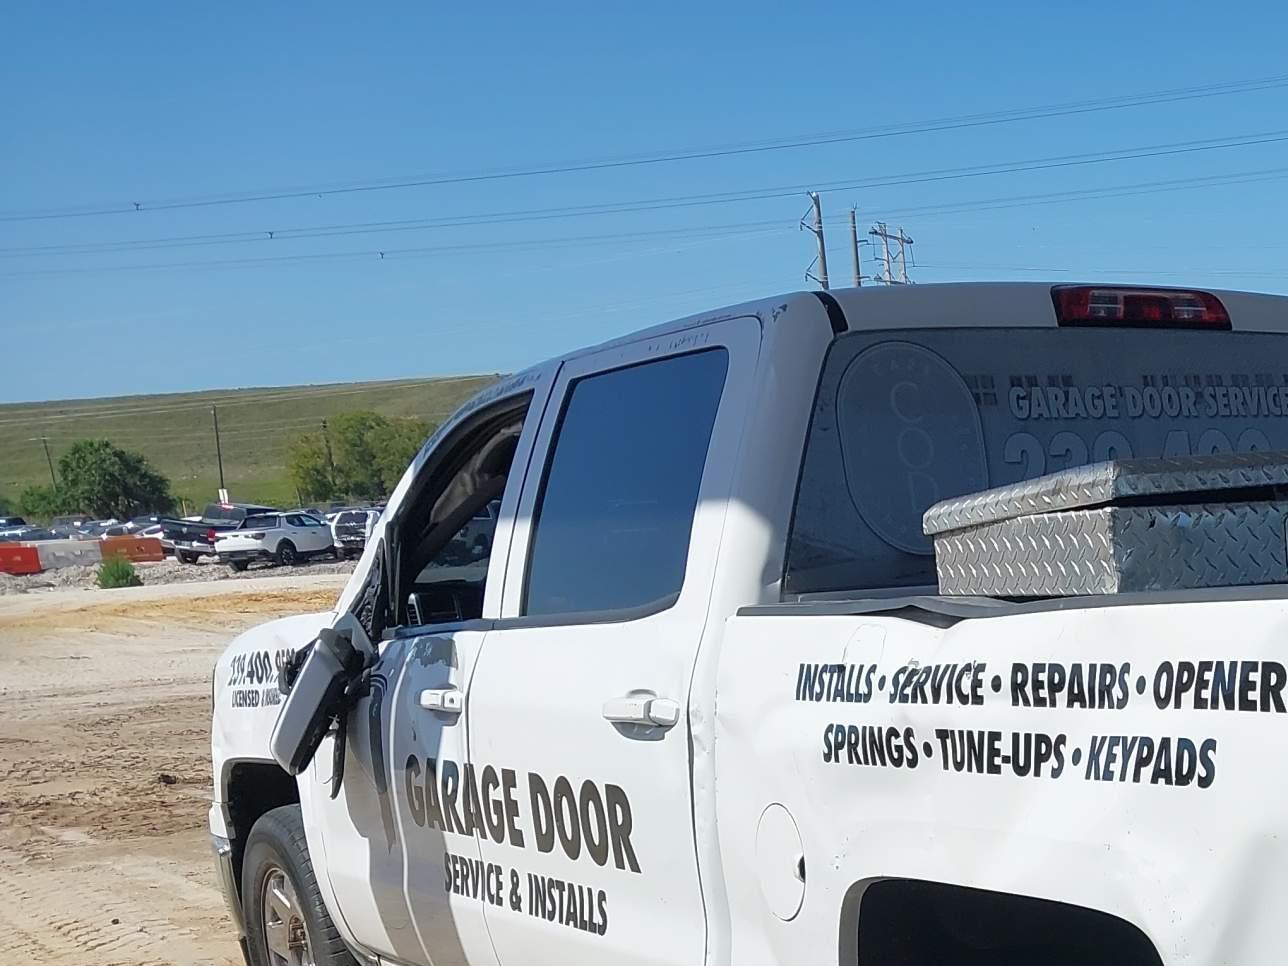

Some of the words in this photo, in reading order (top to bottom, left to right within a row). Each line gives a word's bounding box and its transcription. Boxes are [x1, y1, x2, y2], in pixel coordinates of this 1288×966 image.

[1008, 386, 1120, 420] GARAGE
[1128, 386, 1199, 418] DOOR
[796, 663, 872, 703] INSTALLS
[889, 663, 986, 705] SERVICE
[1011, 663, 1130, 709] REPAIRS
[823, 724, 918, 768] SPRINGS
[935, 729, 1066, 778] TUNE-UPS
[1085, 735, 1217, 788] KEYPADS
[405, 754, 525, 848] GARAGE
[528, 771, 642, 874] DOOR
[445, 853, 503, 907] SERVICE
[510, 868, 522, 912] &
[528, 873, 608, 936] INSTALLS
